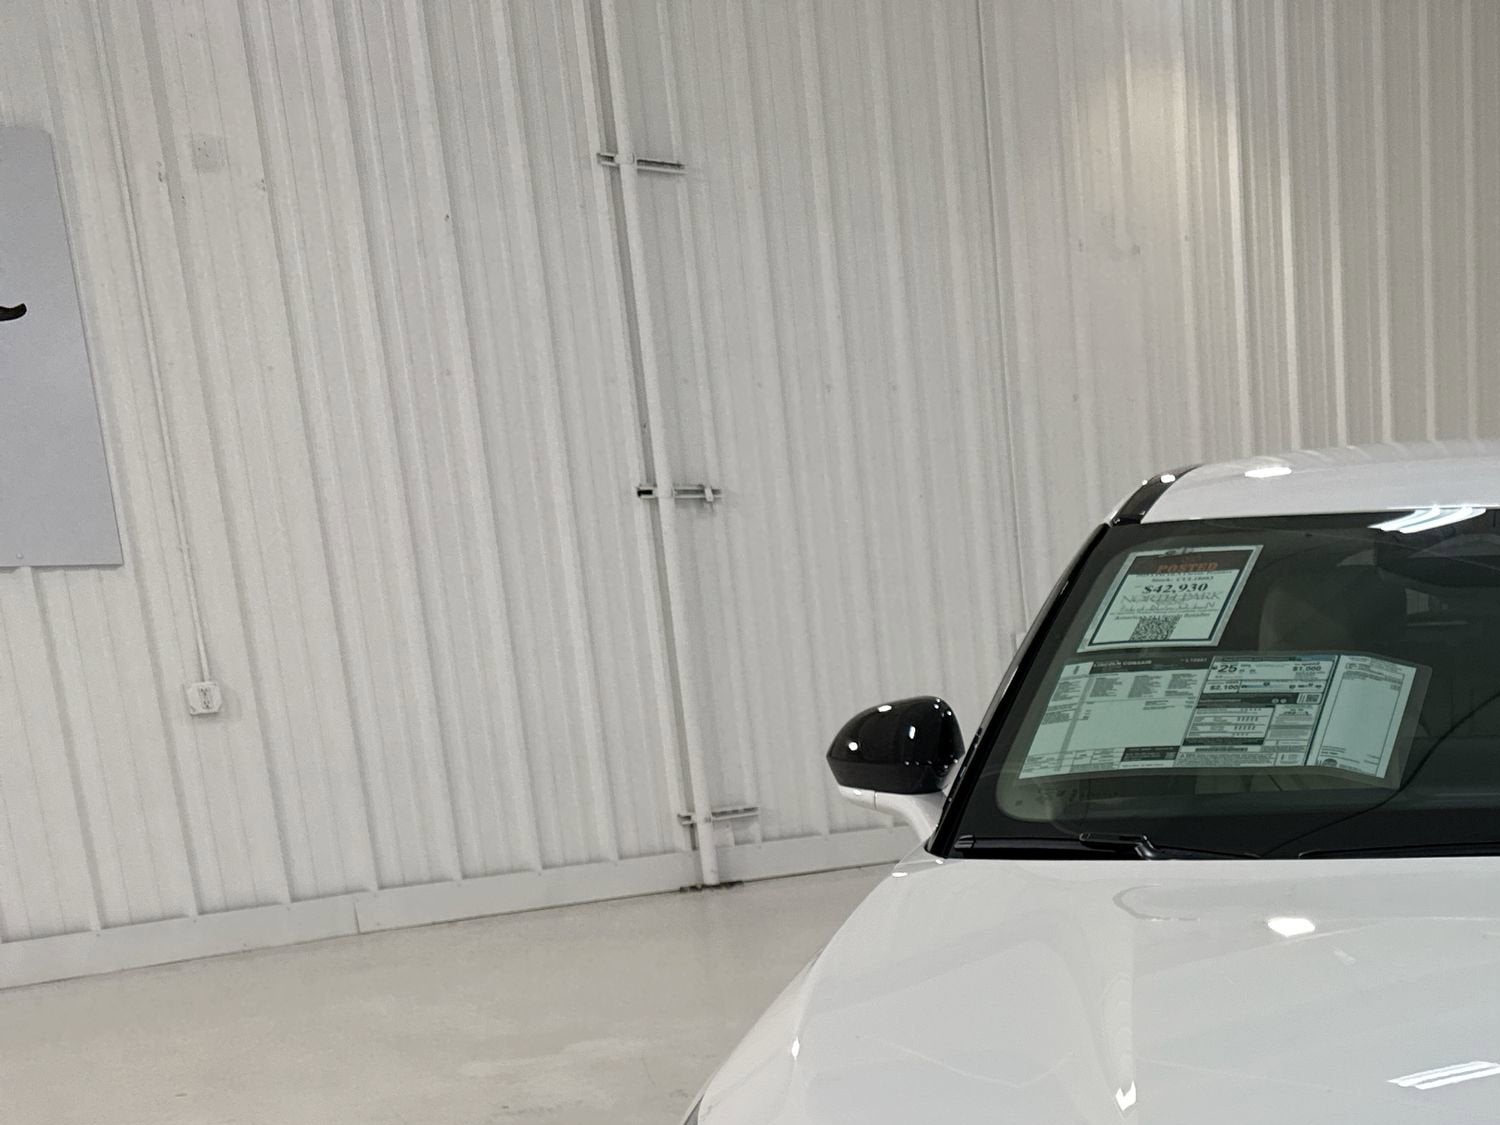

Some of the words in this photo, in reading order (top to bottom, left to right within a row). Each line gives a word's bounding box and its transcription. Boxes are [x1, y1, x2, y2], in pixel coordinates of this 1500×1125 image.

[1157, 562, 1218, 573] POSTED
[1143, 583, 1209, 594] $42,930
[1217, 665, 1238, 673] 25
